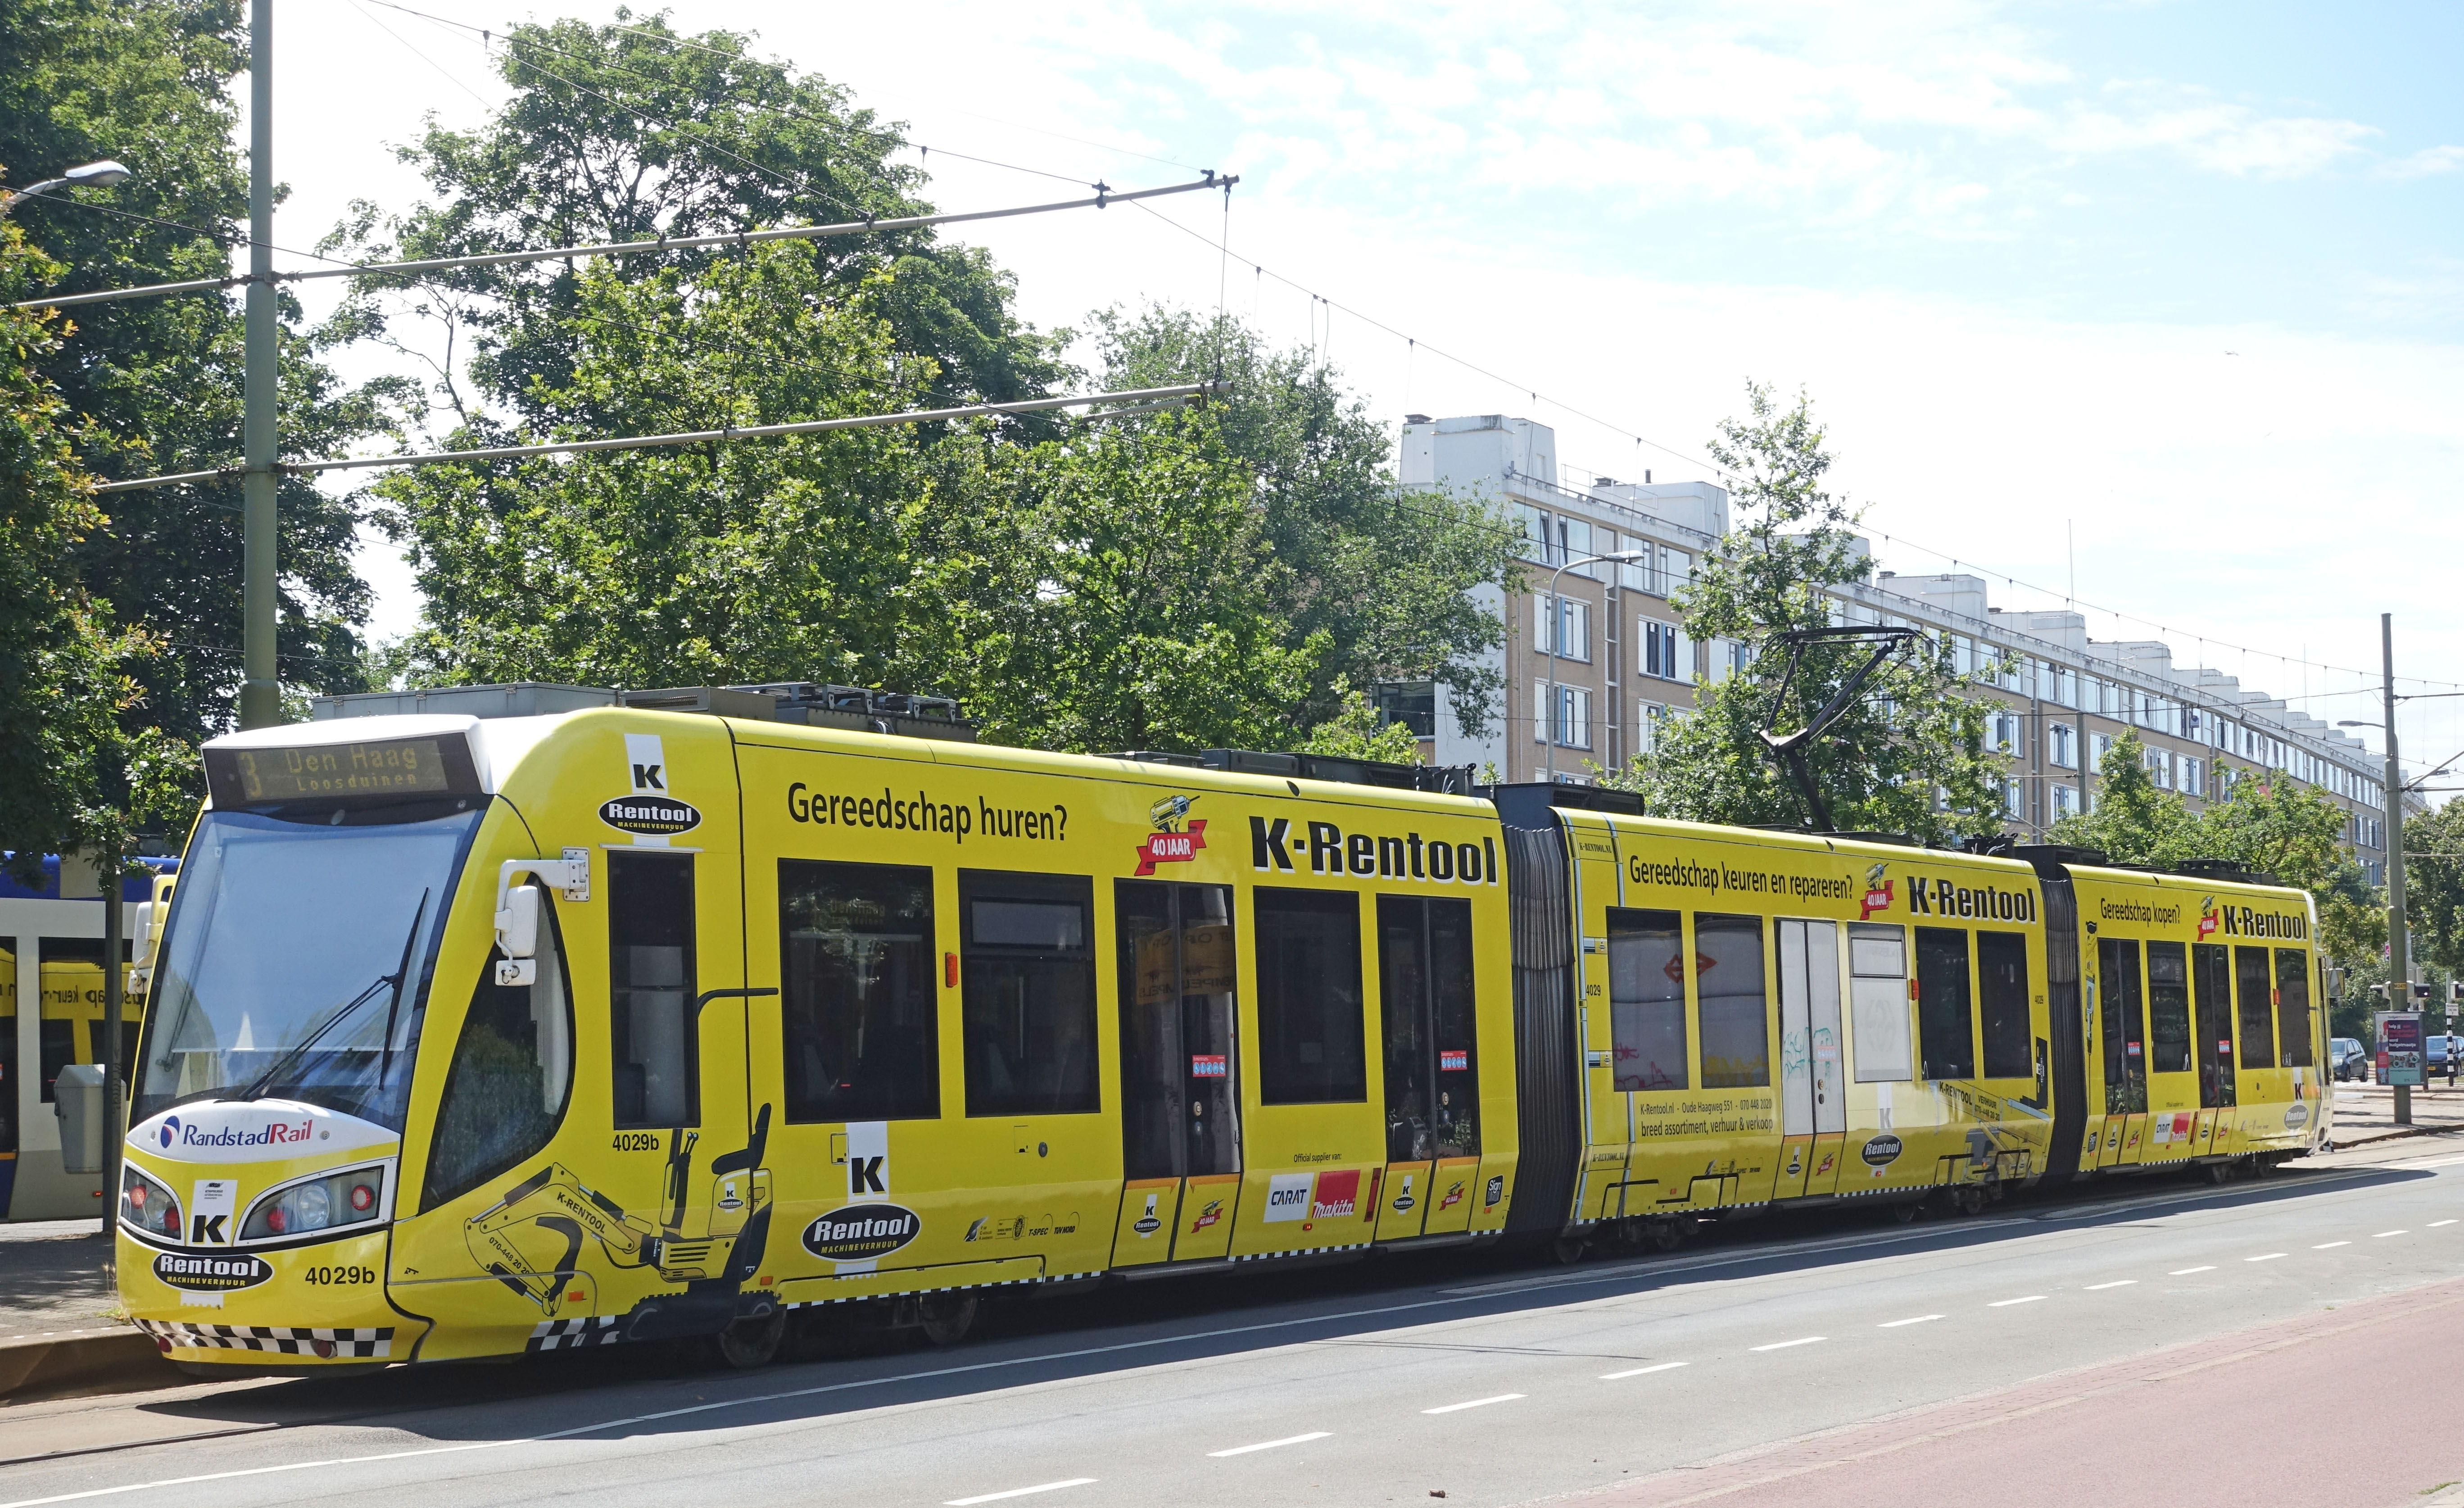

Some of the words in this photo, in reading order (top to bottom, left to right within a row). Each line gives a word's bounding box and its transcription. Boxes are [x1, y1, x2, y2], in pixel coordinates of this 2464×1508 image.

[285, 748, 338, 774] Den
[350, 744, 418, 770] Haag
[238, 751, 262, 798] 3
[297, 773, 417, 792] Loosduinen
[633, 764, 665, 790] K
[608, 803, 692, 822] Rentool
[788, 782, 972, 845] Gereedschap
[978, 795, 1068, 841] huren?
[617, 822, 684, 830] MACHINEVERHUUR
[1151, 838, 1166, 856] 40
[1167, 836, 1191, 855] JAAR
[1248, 816, 1498, 885] K-Rentool
[1579, 842, 1612, 853] K-RENTOOL.NL
[1630, 855, 1719, 895] Gereedschap
[1721, 861, 1767, 892] keuren
[1771, 873, 1786, 894] en
[1789, 874, 1853, 903] repareren?
[1867, 894, 1875, 906] 40
[1875, 893, 1886, 906] JAAR
[1907, 876, 2036, 923] K-Rentool
[2101, 898, 2151, 928] Gereedschap
[2152, 901, 2180, 928] kopen?
[2222, 905, 2307, 940] K-Rentool
[1586, 985, 1601, 996] 4029
[1939, 1081, 1973, 1105] K-RENTOOL
[2294, 1083, 2302, 1099] K
[1640, 1102, 1674, 1115] K-Rentool.nl
[1682, 1101, 1696, 1113] Oude
[1698, 1101, 1722, 1115] Haagweg
[1724, 1101, 1733, 1111] 551
[1740, 1099, 1749, 1110] 070
[1750, 1099, 1759, 1110] 448
[1760, 1098, 1772, 1109] 2020
[1978, 1095, 1997, 1109] VERHUUR
[1879, 1108, 1892, 1129] K
[2286, 1110, 2307, 1121] Rentool
[183, 1119, 313, 1146] RandstadRail
[1641, 1120, 1662, 1137] breed
[1665, 1119, 1708, 1135] assortiment,
[1711, 1117, 1738, 1132] verhuur
[1739, 1117, 1744, 1131] &
[1746, 1115, 1773, 1133] verkoop
[612, 1133, 659, 1152] 4029b
[1865, 1141, 1900, 1156] Rentool
[1294, 1153, 1311, 1163] Official
[1312, 1152, 1331, 1163] supplier
[851, 1156, 886, 1194] K
[1402, 1186, 1410, 1195] K
[1489, 1180, 1501, 1194] Sign
[1271, 1189, 1307, 1206] CARAT
[557, 1192, 606, 1234] K-RENTOOL
[1145, 1205, 1155, 1216] K
[192, 1215, 229, 1244] K
[813, 1214, 911, 1242] Rentool
[1029, 1228, 1049, 1236] T-SPEC
[1136, 1221, 1159, 1229] Rentool
[489, 1237, 514, 1262] 070-448
[512, 1259, 522, 1269] 20
[821, 1240, 897, 1254] MACHINEVERHUUR
[160, 1255, 259, 1277] Rentool
[305, 1266, 376, 1285] 4029b
[167, 1276, 246, 1286] MACHINEVERHUUR
